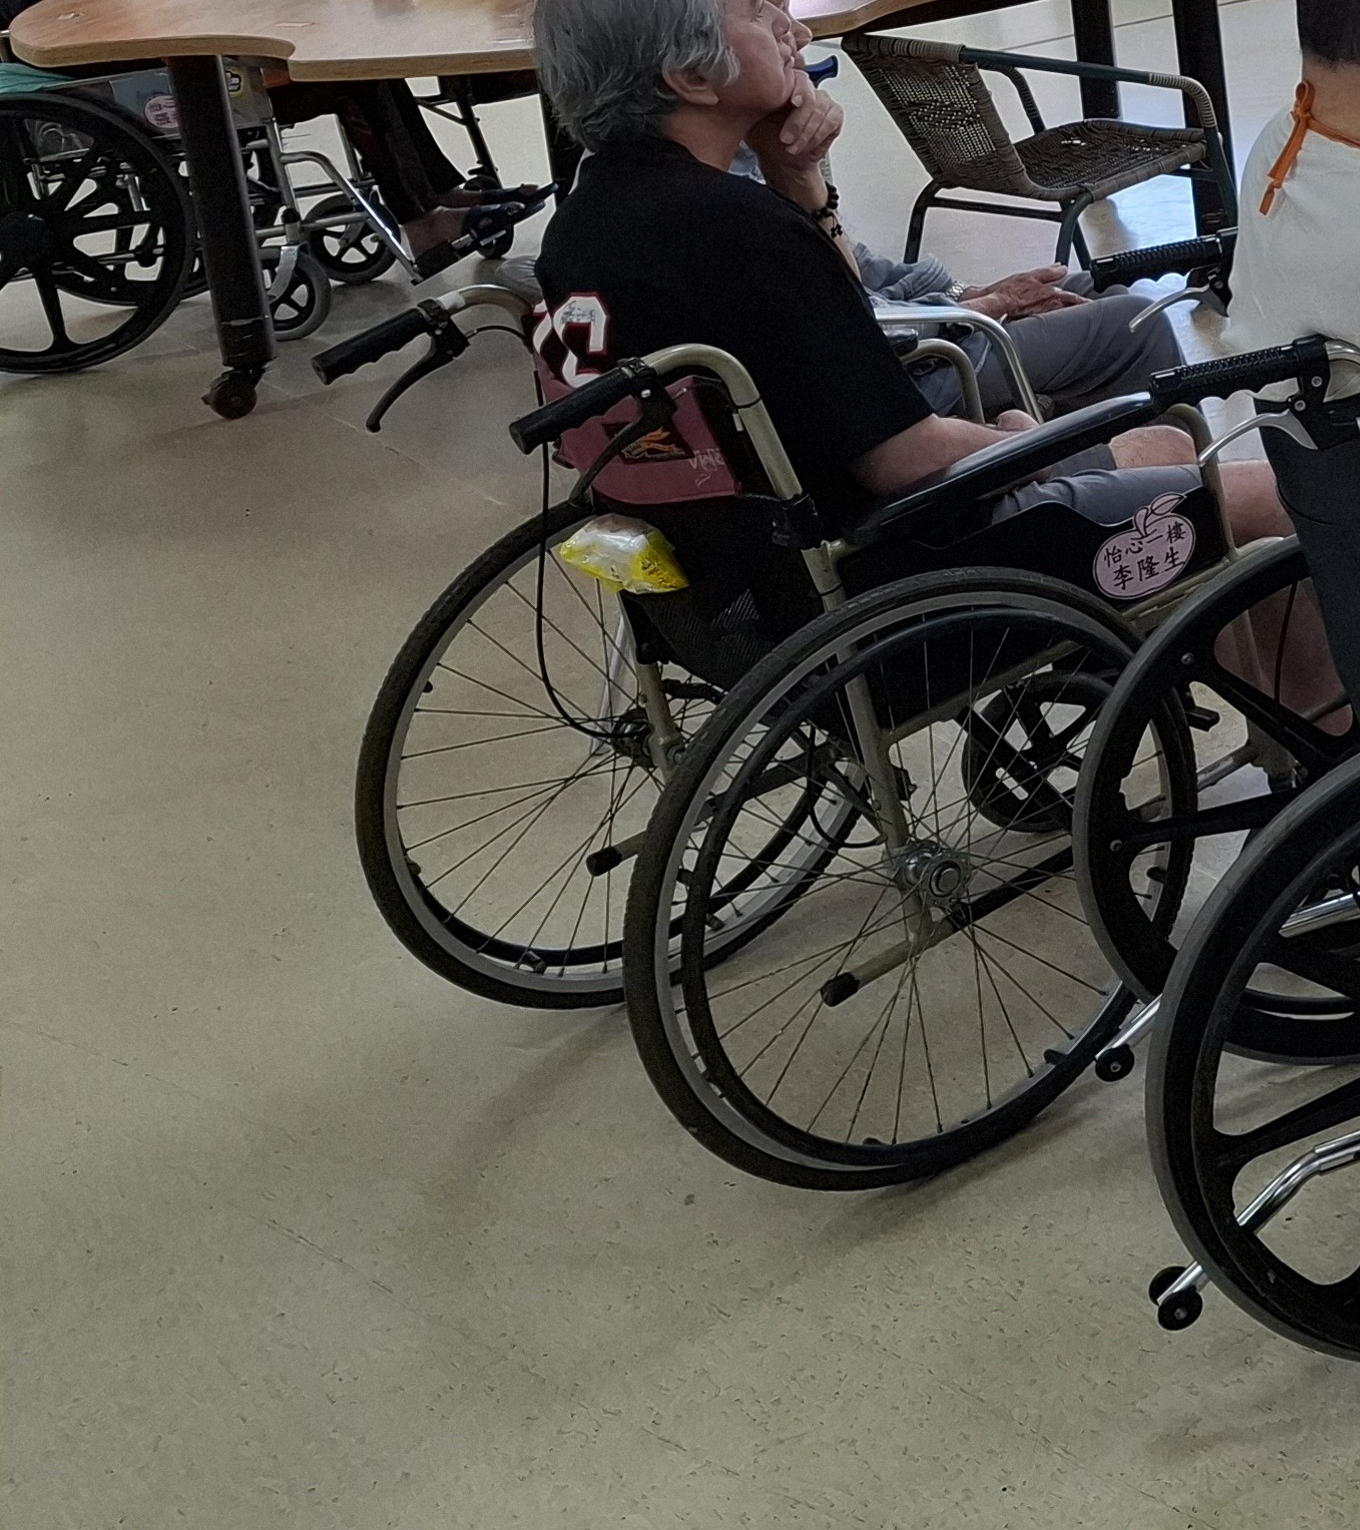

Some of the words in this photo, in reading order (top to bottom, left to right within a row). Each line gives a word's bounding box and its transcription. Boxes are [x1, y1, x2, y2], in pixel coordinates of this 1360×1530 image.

[1103, 520, 1187, 568] 怡心一樓
[1113, 546, 1186, 591] 李隆生
